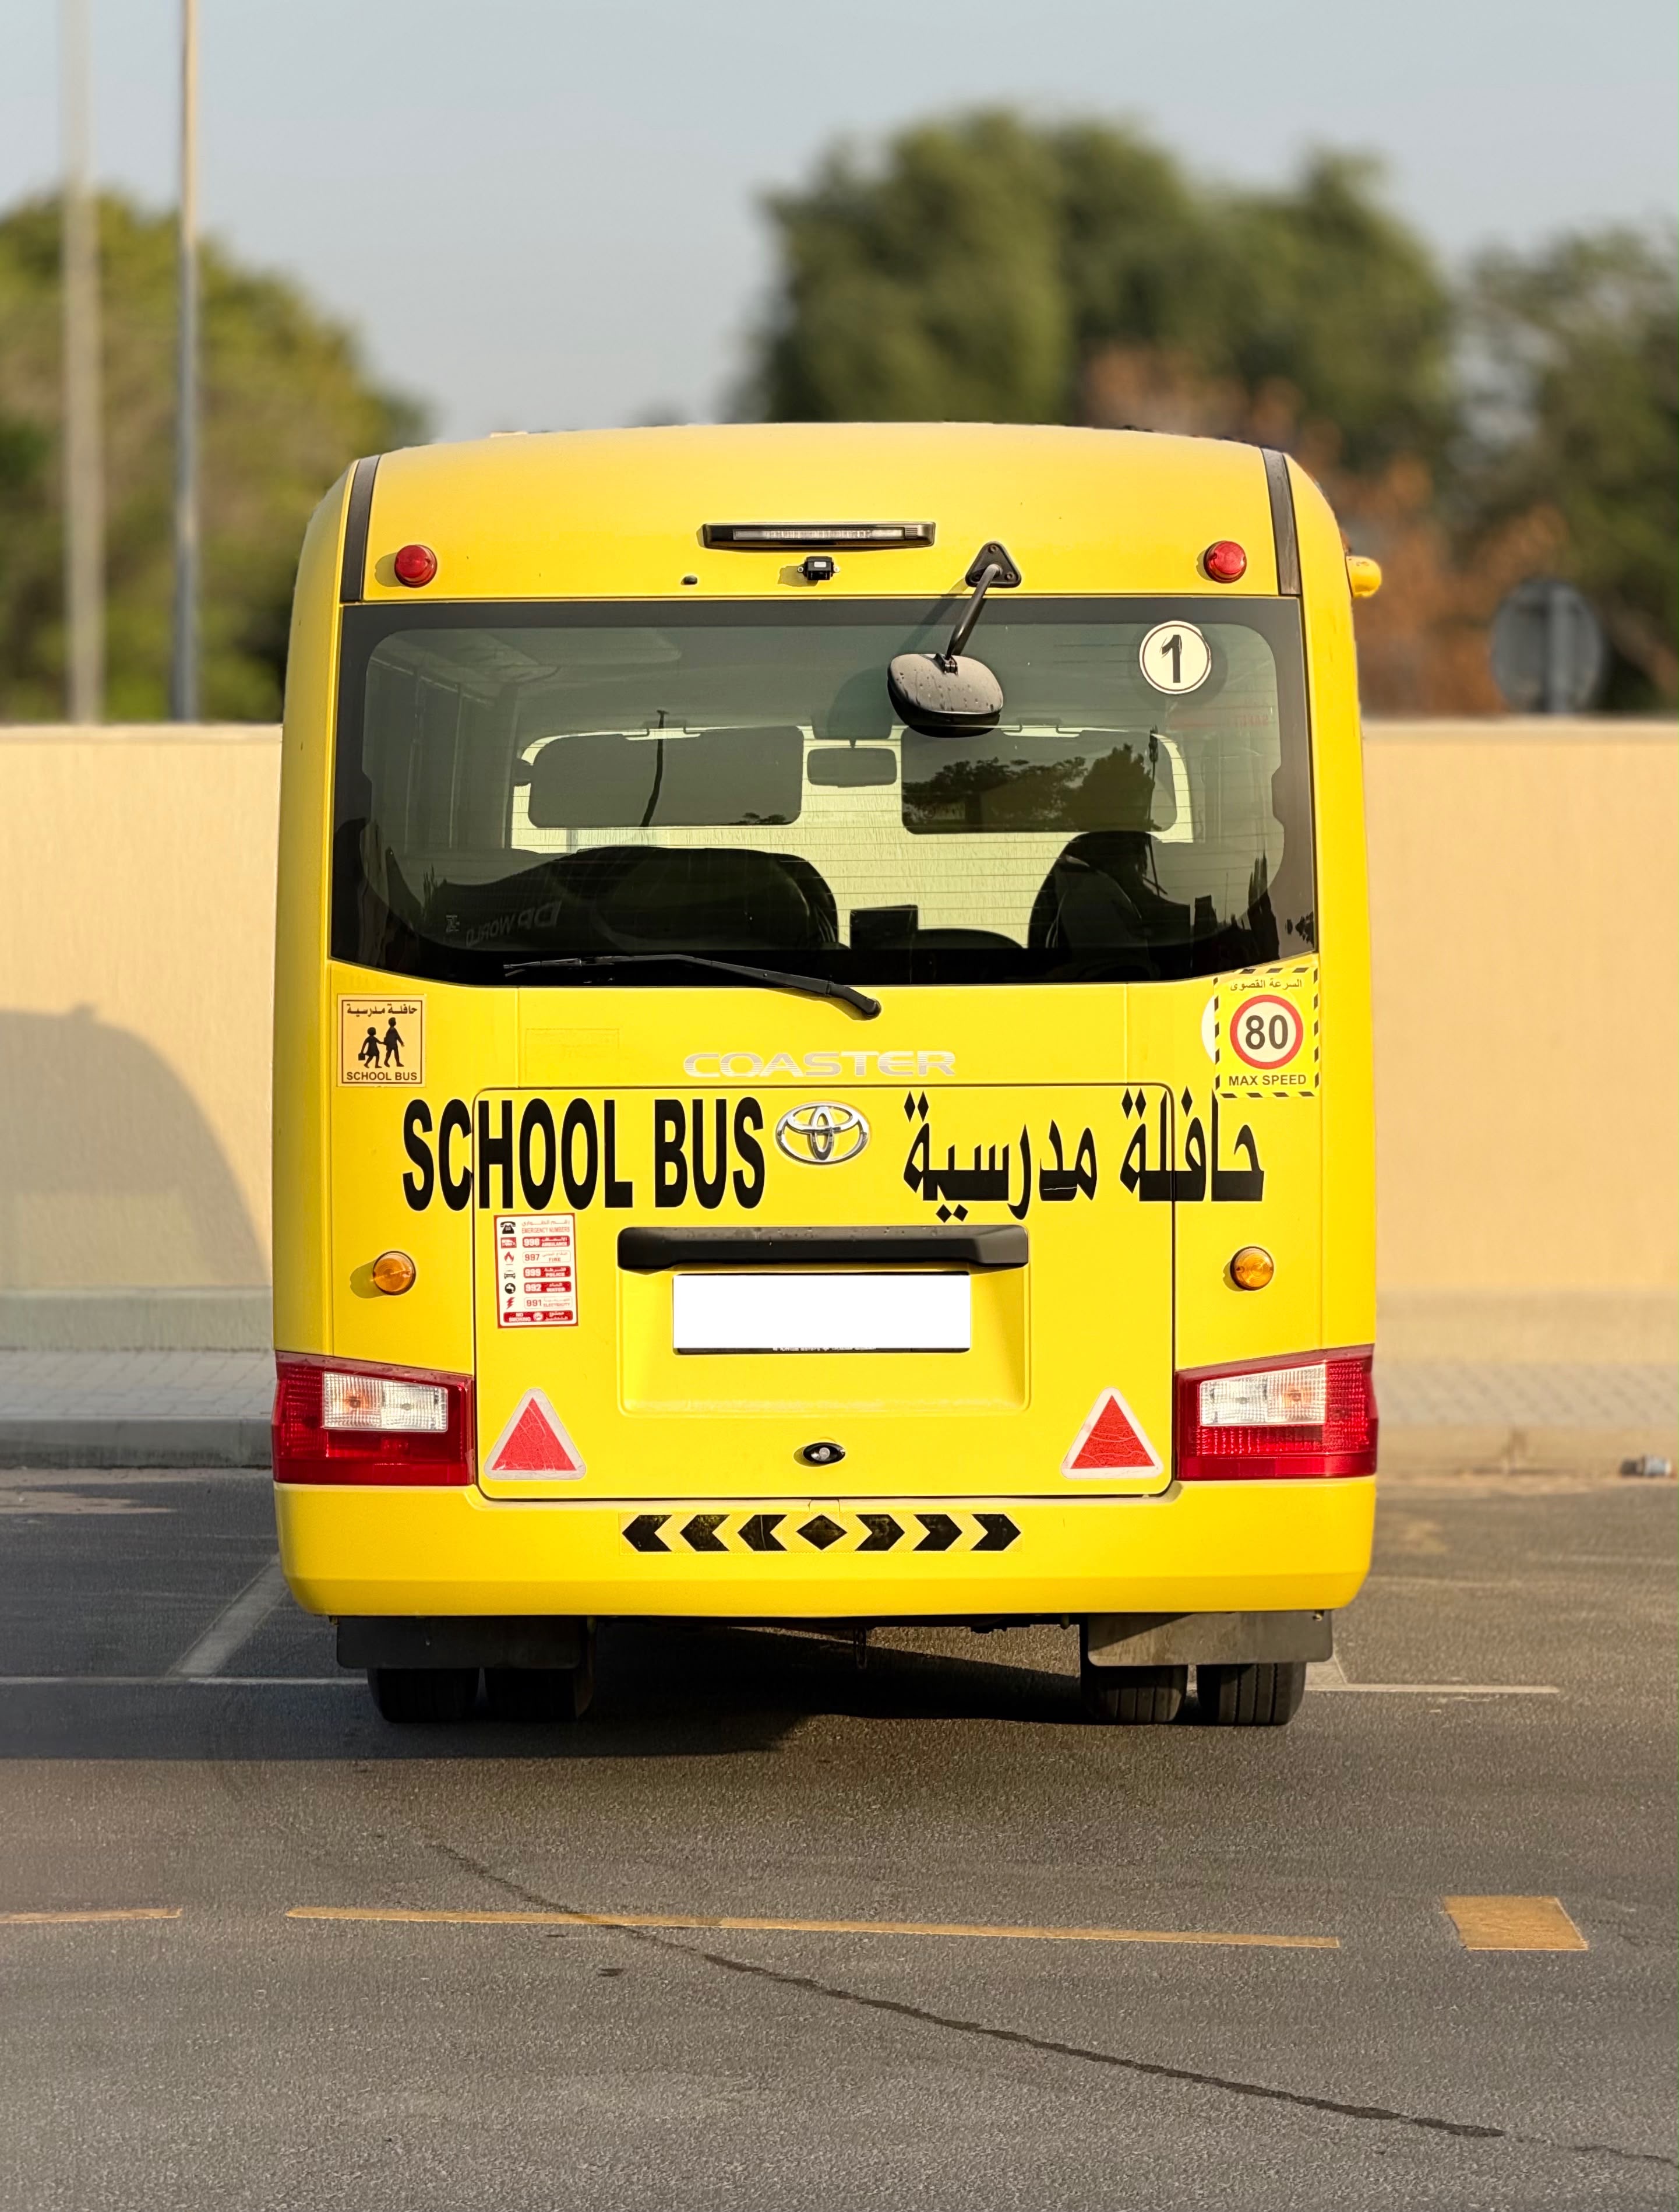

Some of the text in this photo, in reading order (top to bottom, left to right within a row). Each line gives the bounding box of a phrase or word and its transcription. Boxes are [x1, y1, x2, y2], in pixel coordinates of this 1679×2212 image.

[1160, 634, 1183, 684] 1
[1269, 978, 1303, 991] السرعة
[1245, 1014, 1289, 1050] 80
[346, 1071, 418, 1081] SCHOOL BUS
[683, 1051, 956, 1078] COASTER
[1228, 1074, 1307, 1086] MAX SPEED
[403, 1096, 766, 1211] SCHOOL BUS
[903, 1086, 1265, 1223] حافلة مدرسية
